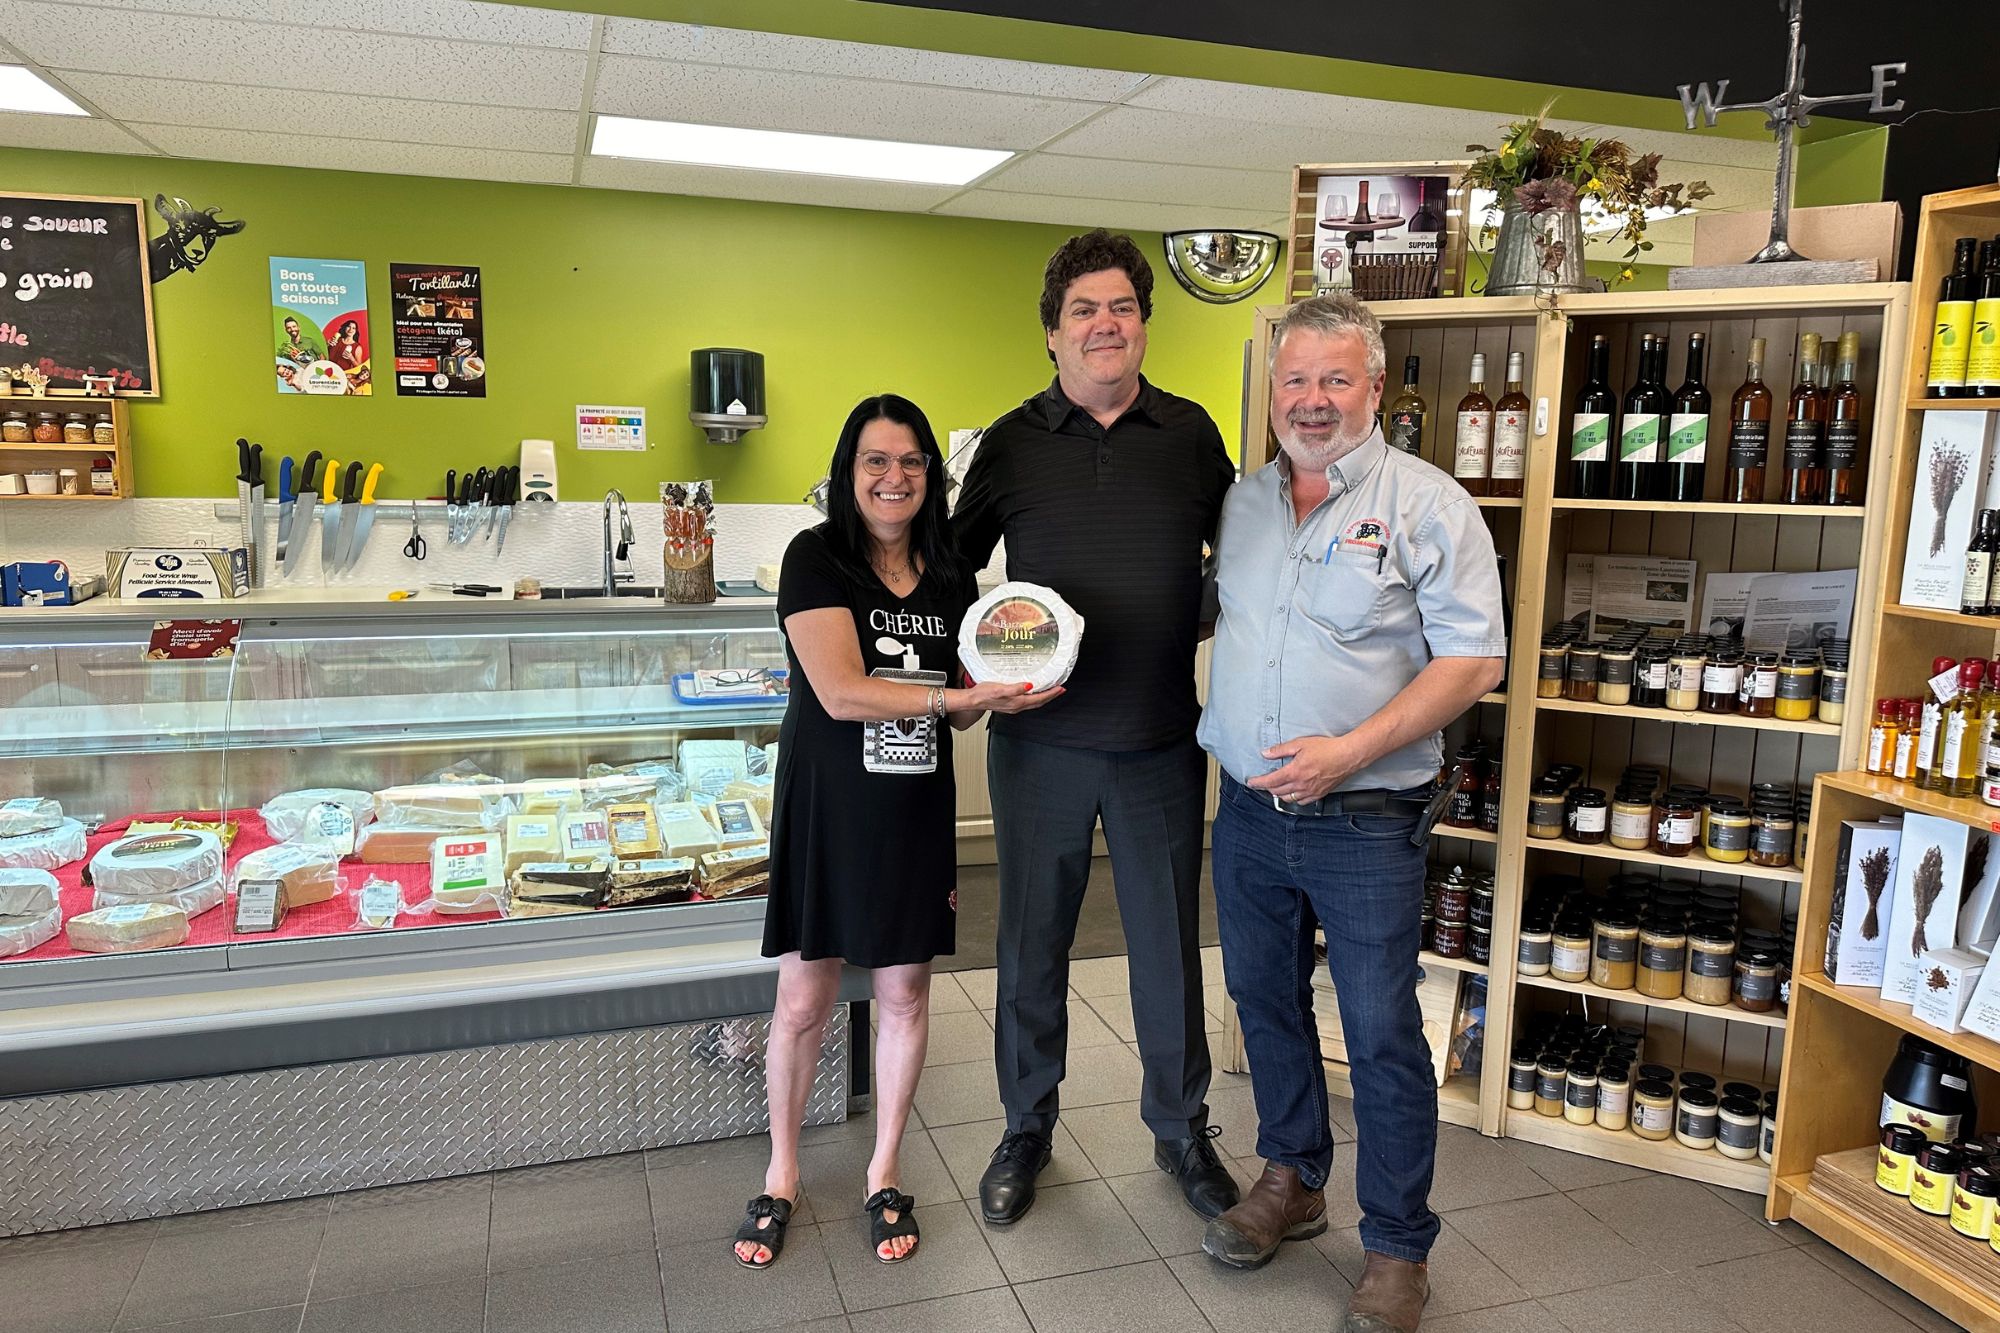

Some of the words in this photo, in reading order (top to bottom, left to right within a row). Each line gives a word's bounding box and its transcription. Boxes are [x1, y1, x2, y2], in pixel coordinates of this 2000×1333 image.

[1869, 62, 1907, 114] E
[1676, 80, 1730, 129] W
[280, 269, 315, 281] Bons
[408, 273, 478, 291] Tortillard!
[14, 267, 93, 302] grain
[281, 283, 299, 291] en
[301, 282, 347, 294] toutes
[281, 293, 339, 305] saisons!
[396, 326, 436, 336] cétogène
[437, 326, 463, 336] (kéto)
[869, 608, 947, 637] CHÉRIE
[1001, 627, 1036, 643] Jour
